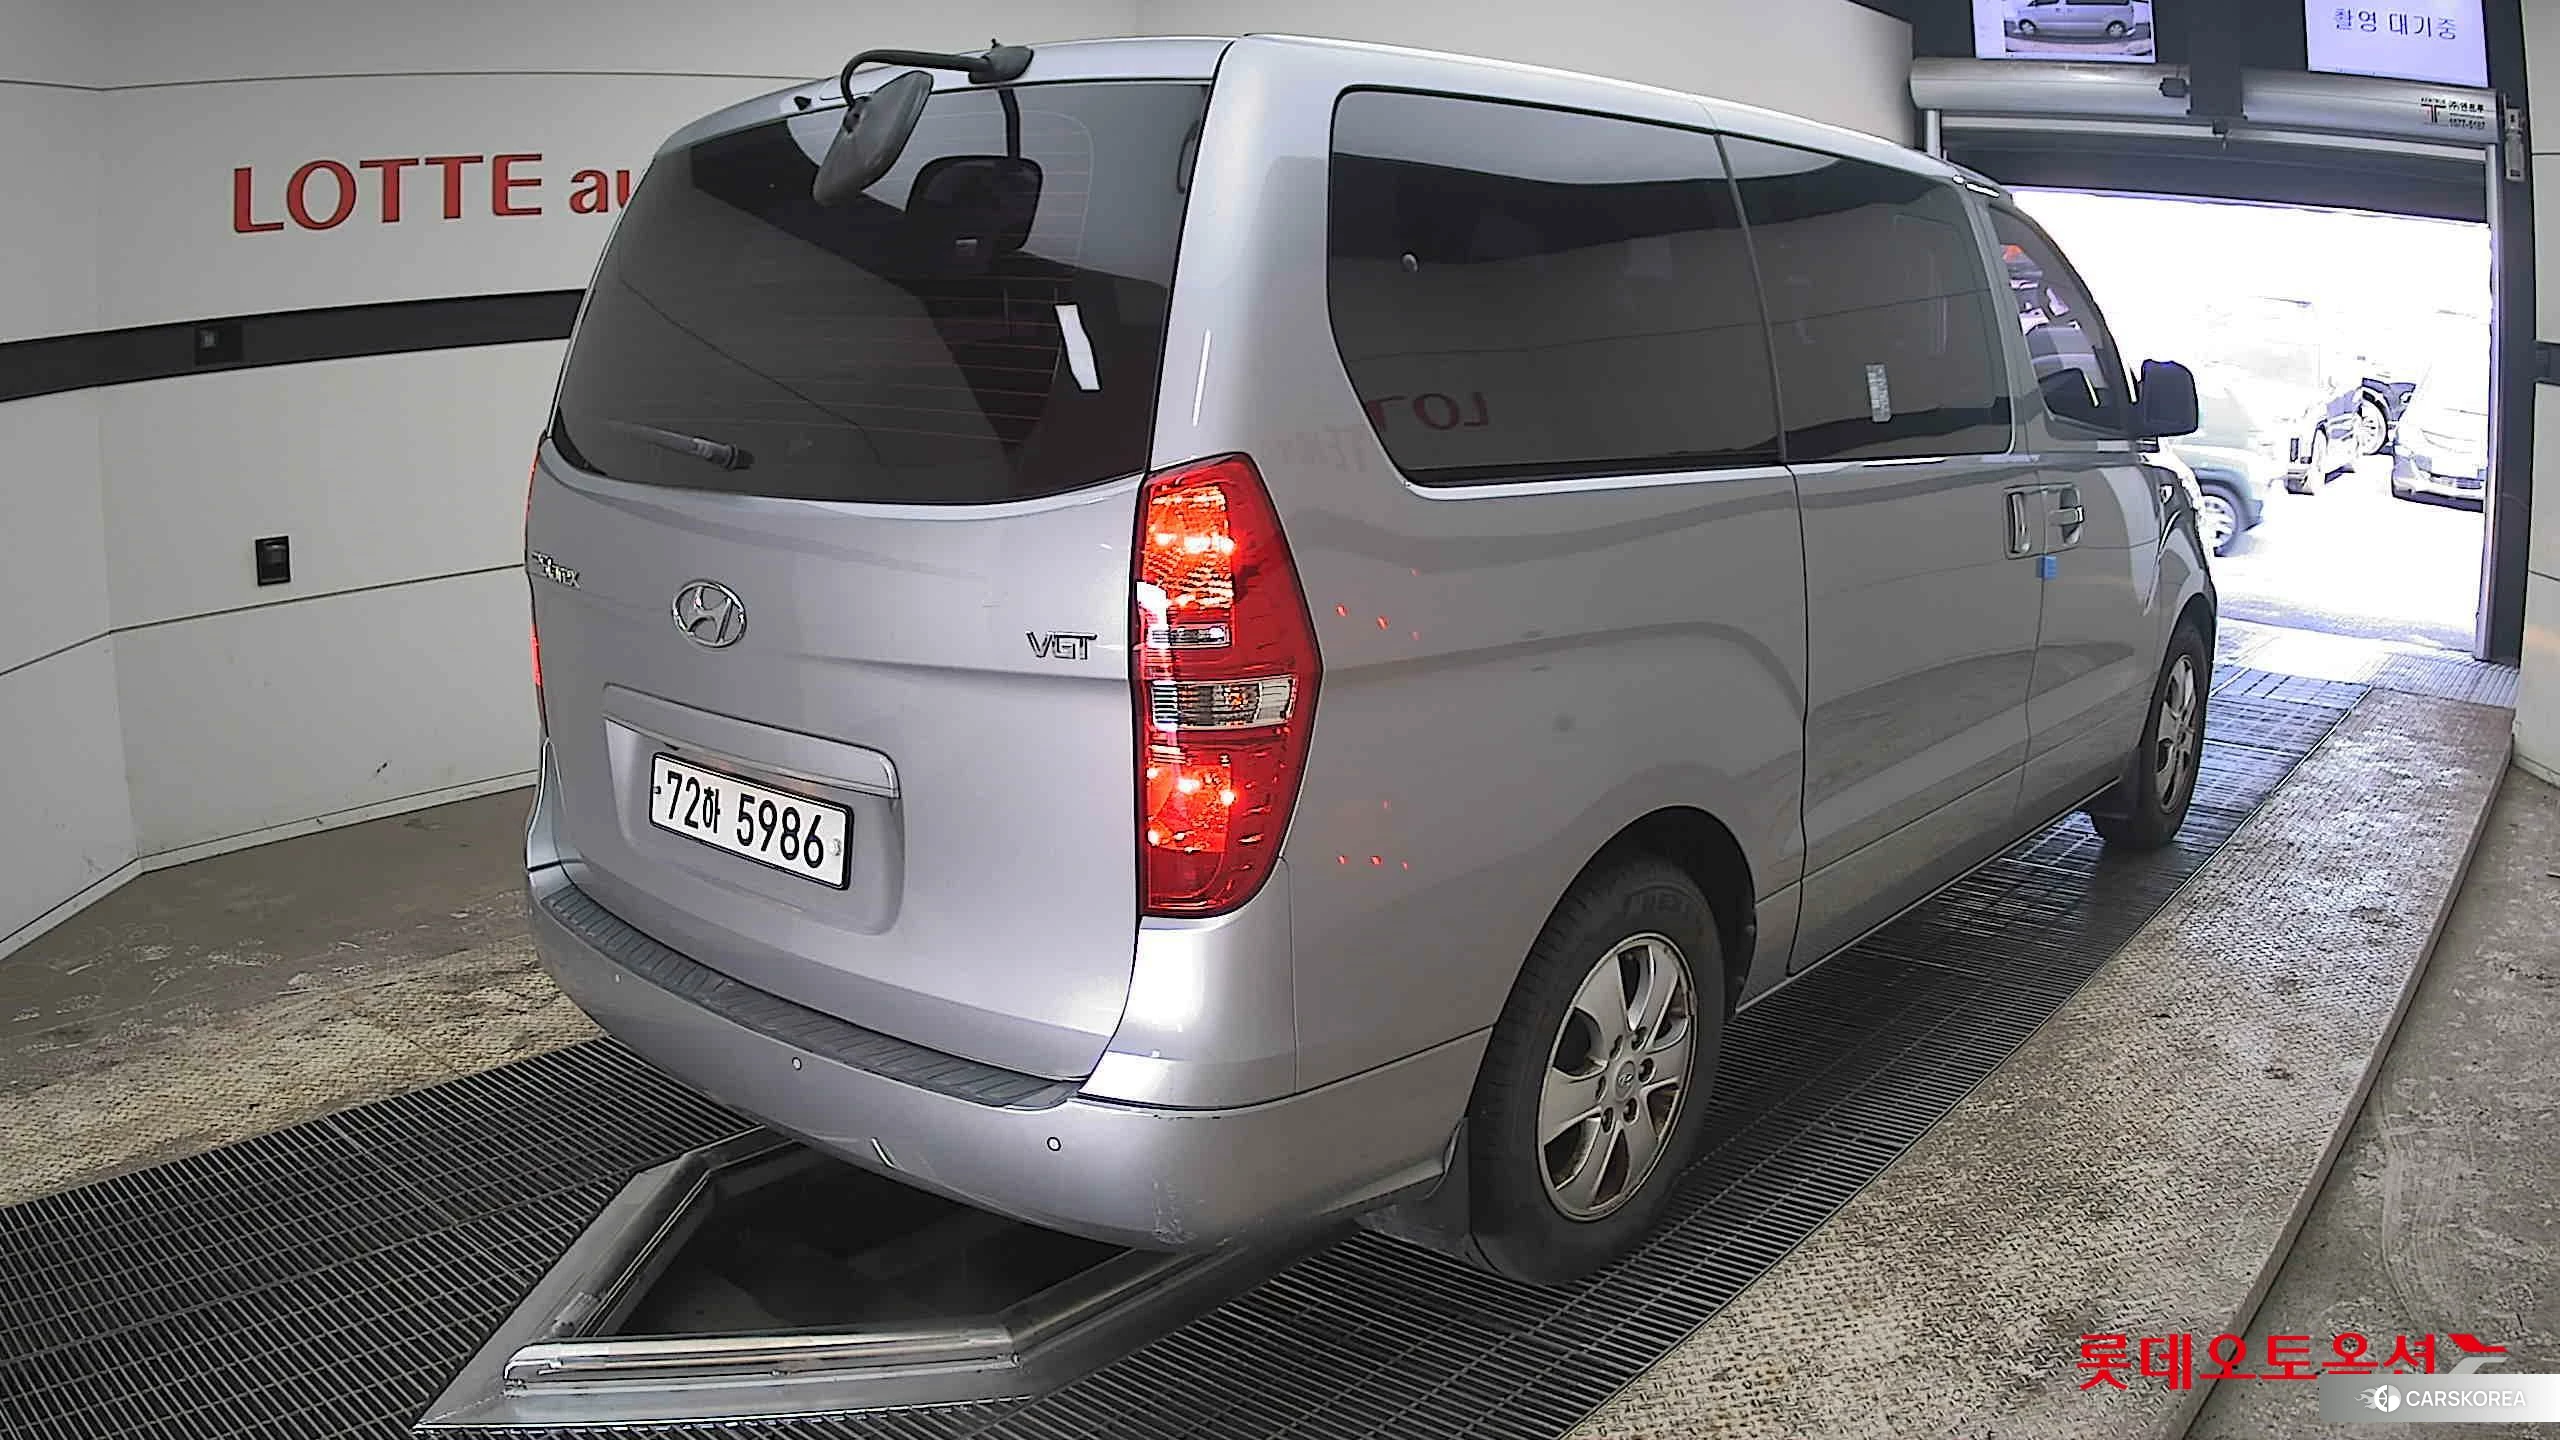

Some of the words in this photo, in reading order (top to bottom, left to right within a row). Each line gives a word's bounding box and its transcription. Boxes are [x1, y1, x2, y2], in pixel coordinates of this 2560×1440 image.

[2335, 8, 2377, 33] 촬영
[2388, 12, 2456, 41] 대기중
[233, 153, 543, 233] LOTTE
[1025, 631, 1098, 661] VGT
[667, 770, 721, 834] 72하
[736, 793, 824, 869] 5986
